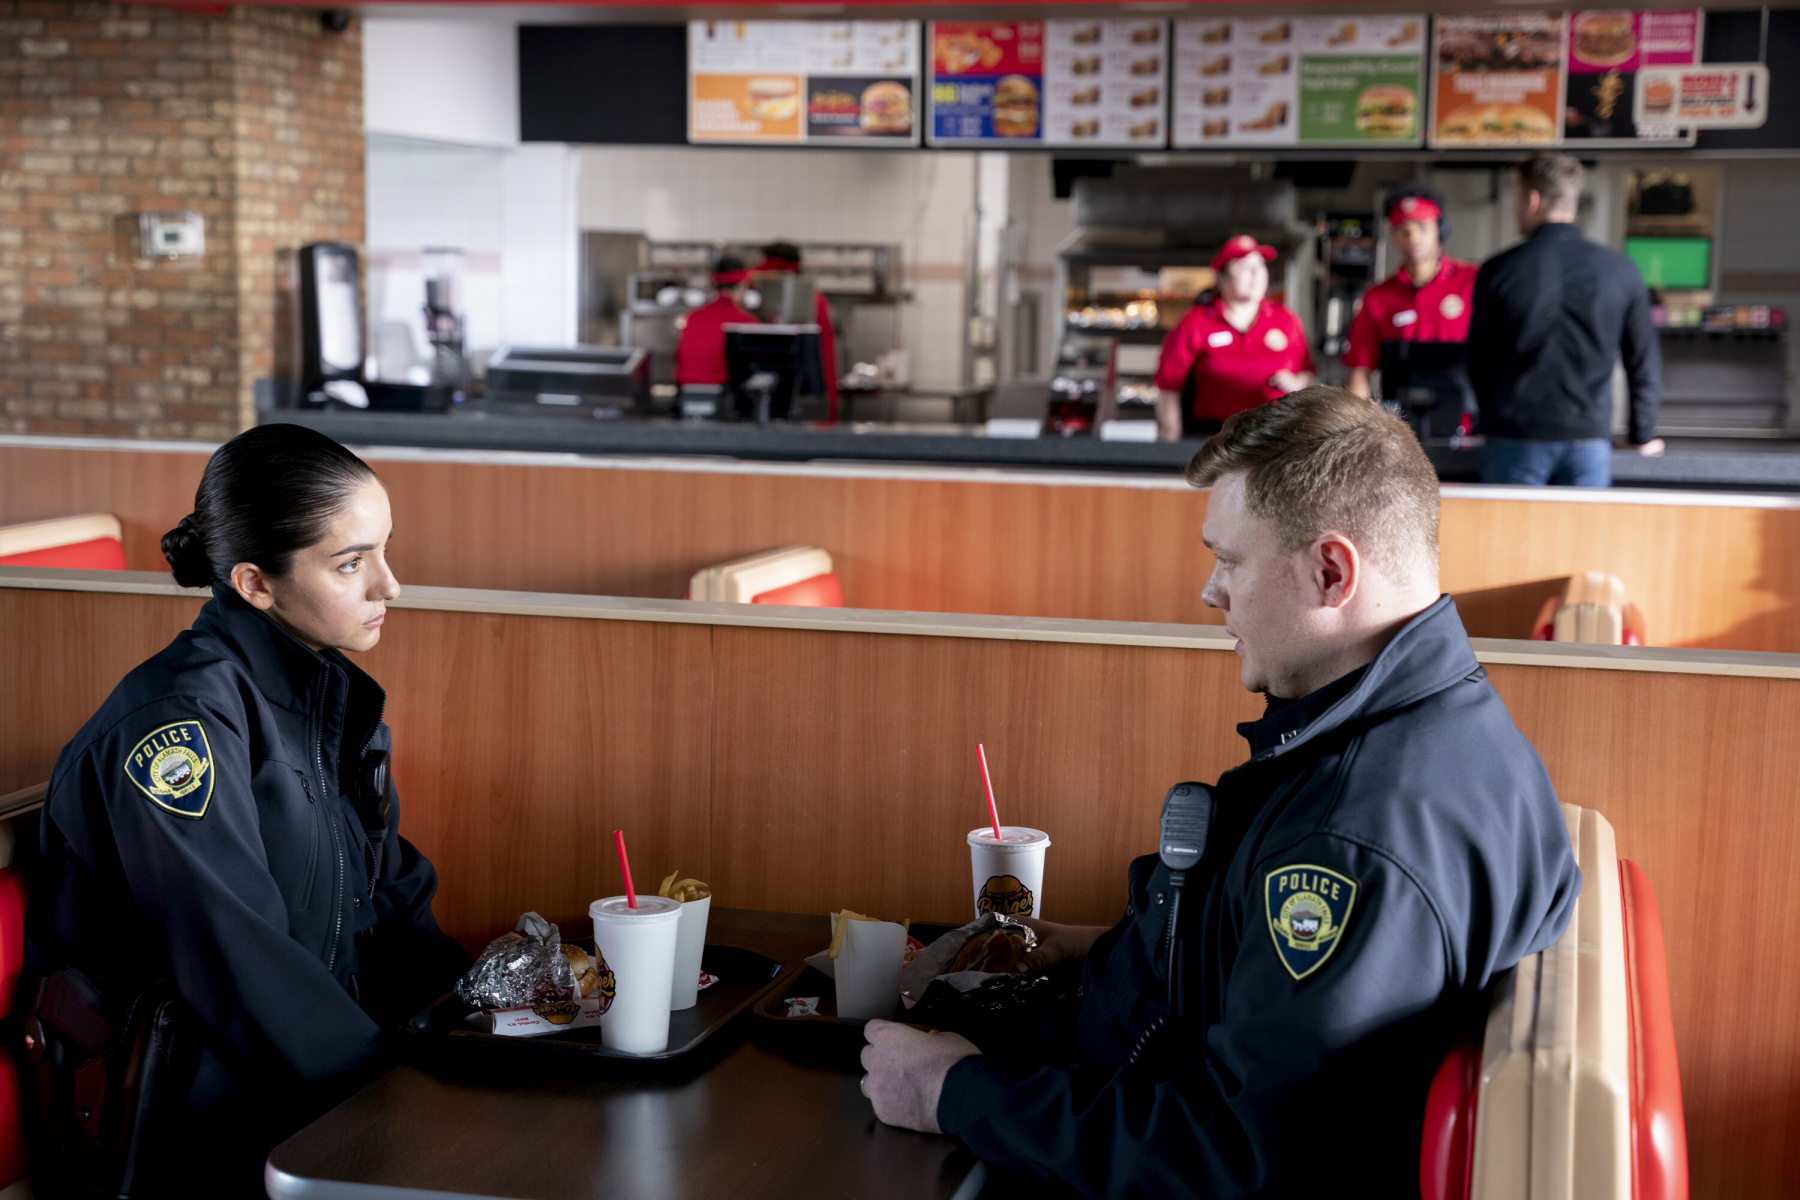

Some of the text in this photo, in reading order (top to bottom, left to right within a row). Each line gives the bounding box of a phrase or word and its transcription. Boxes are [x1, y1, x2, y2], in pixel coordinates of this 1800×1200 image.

[135, 728, 192, 768] POLICE
[182, 749, 197, 763] FALLS
[1279, 873, 1340, 900] POLICE
[978, 892, 1032, 914] Burger
[534, 1001, 579, 1014] Burger
